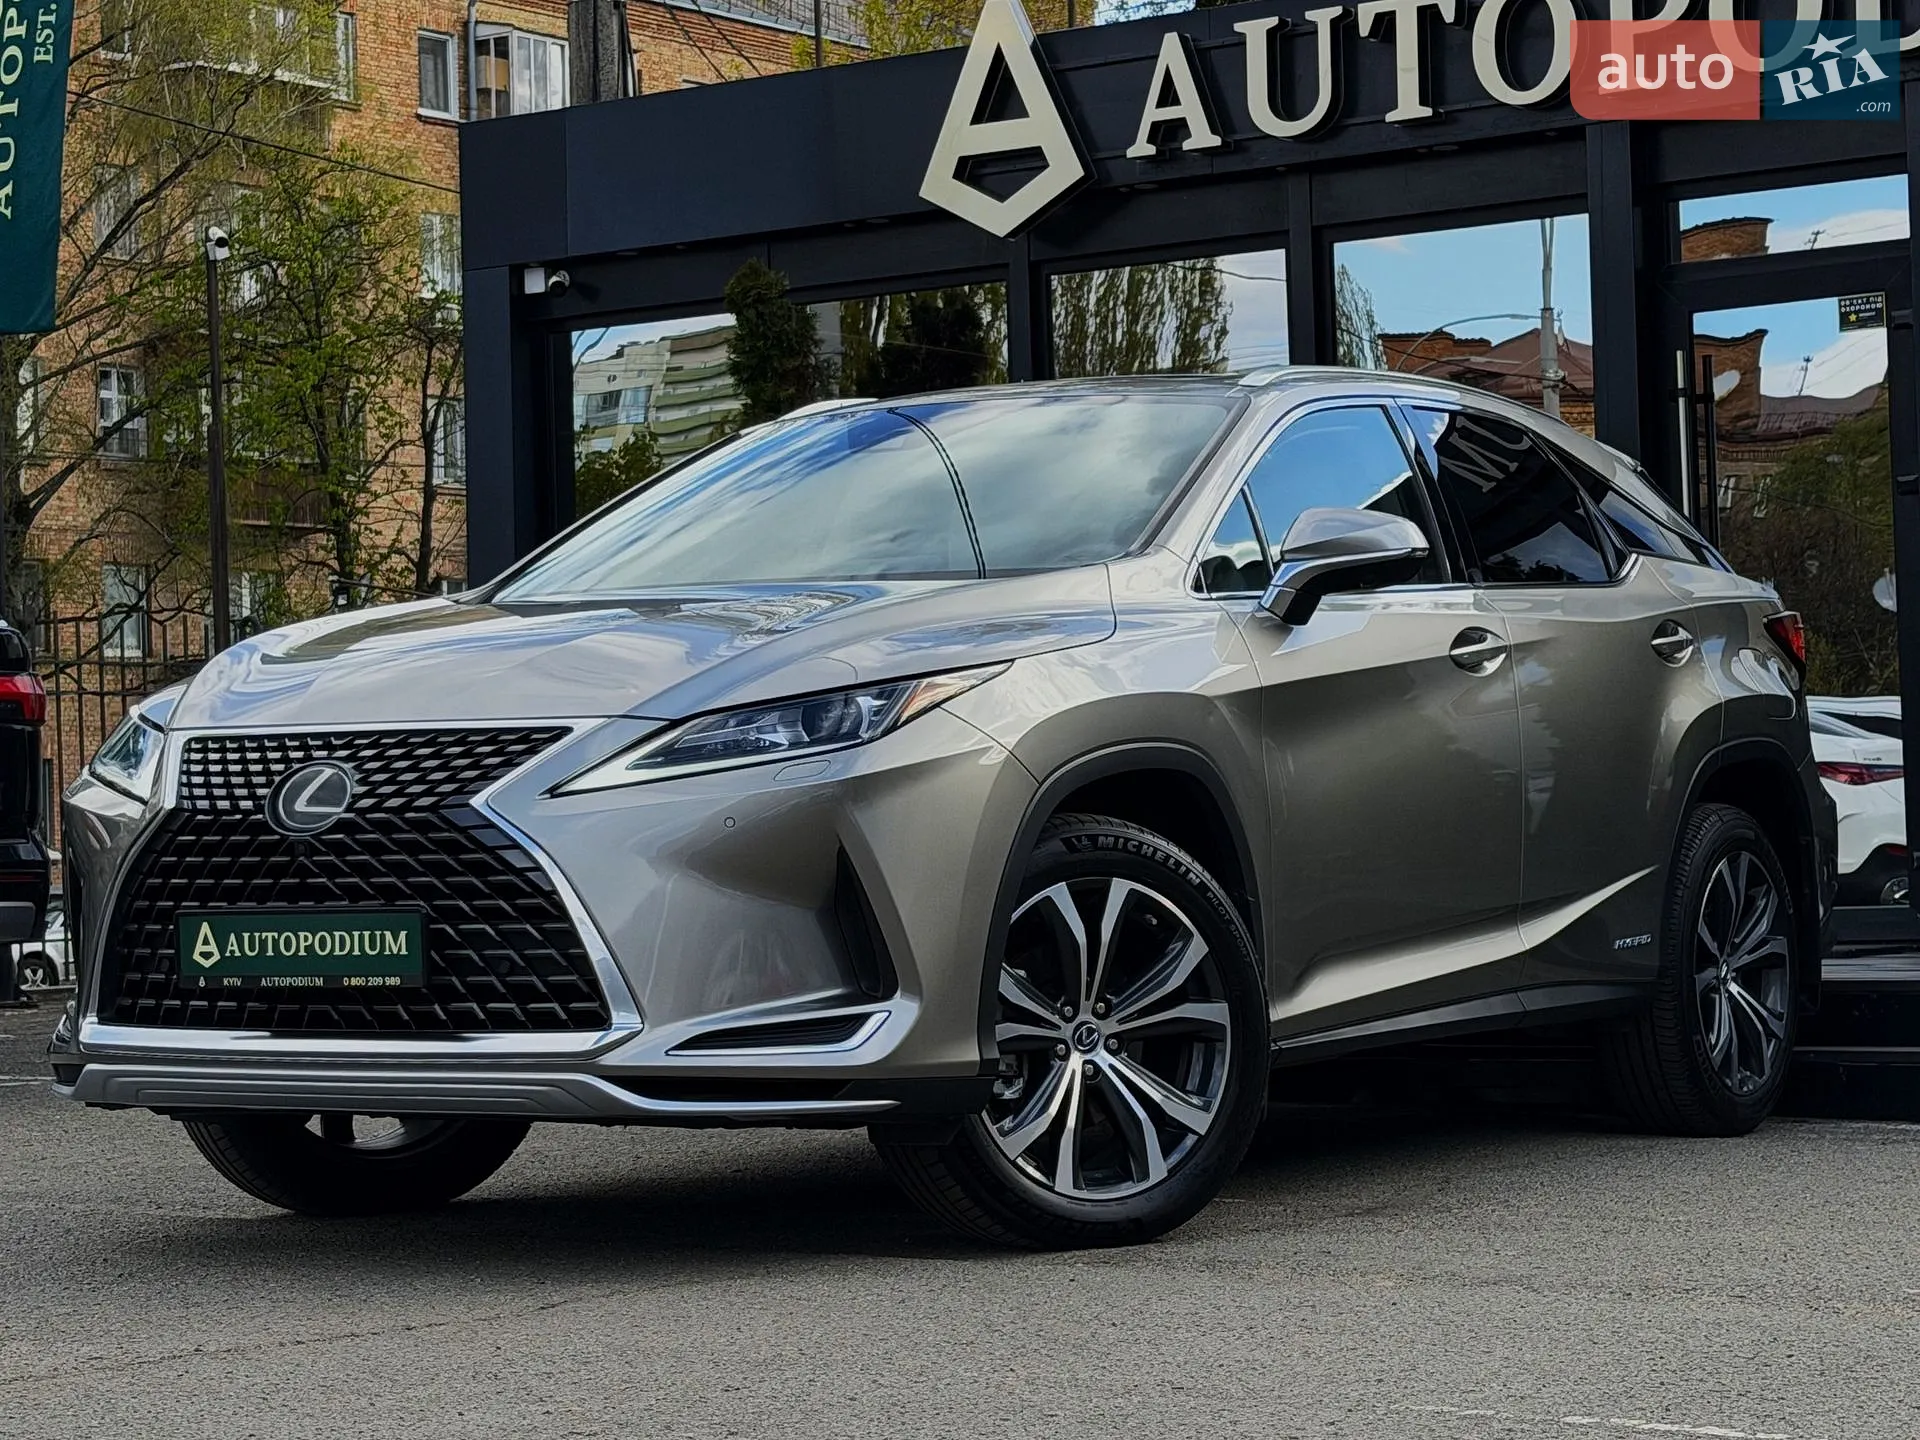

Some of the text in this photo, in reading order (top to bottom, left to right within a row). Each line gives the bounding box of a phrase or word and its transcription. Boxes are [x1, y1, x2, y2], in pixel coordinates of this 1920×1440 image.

[33, 3, 57, 64] EST.
[0, 0, 27, 220] AUTOP
[1097, 835, 1202, 887] MICHELIN
[1206, 890, 1231, 921] PILOT
[224, 930, 409, 957] AUTOPODIUM
[223, 976, 400, 987] KYIV AUTOPODIUM 0 800 209 989
